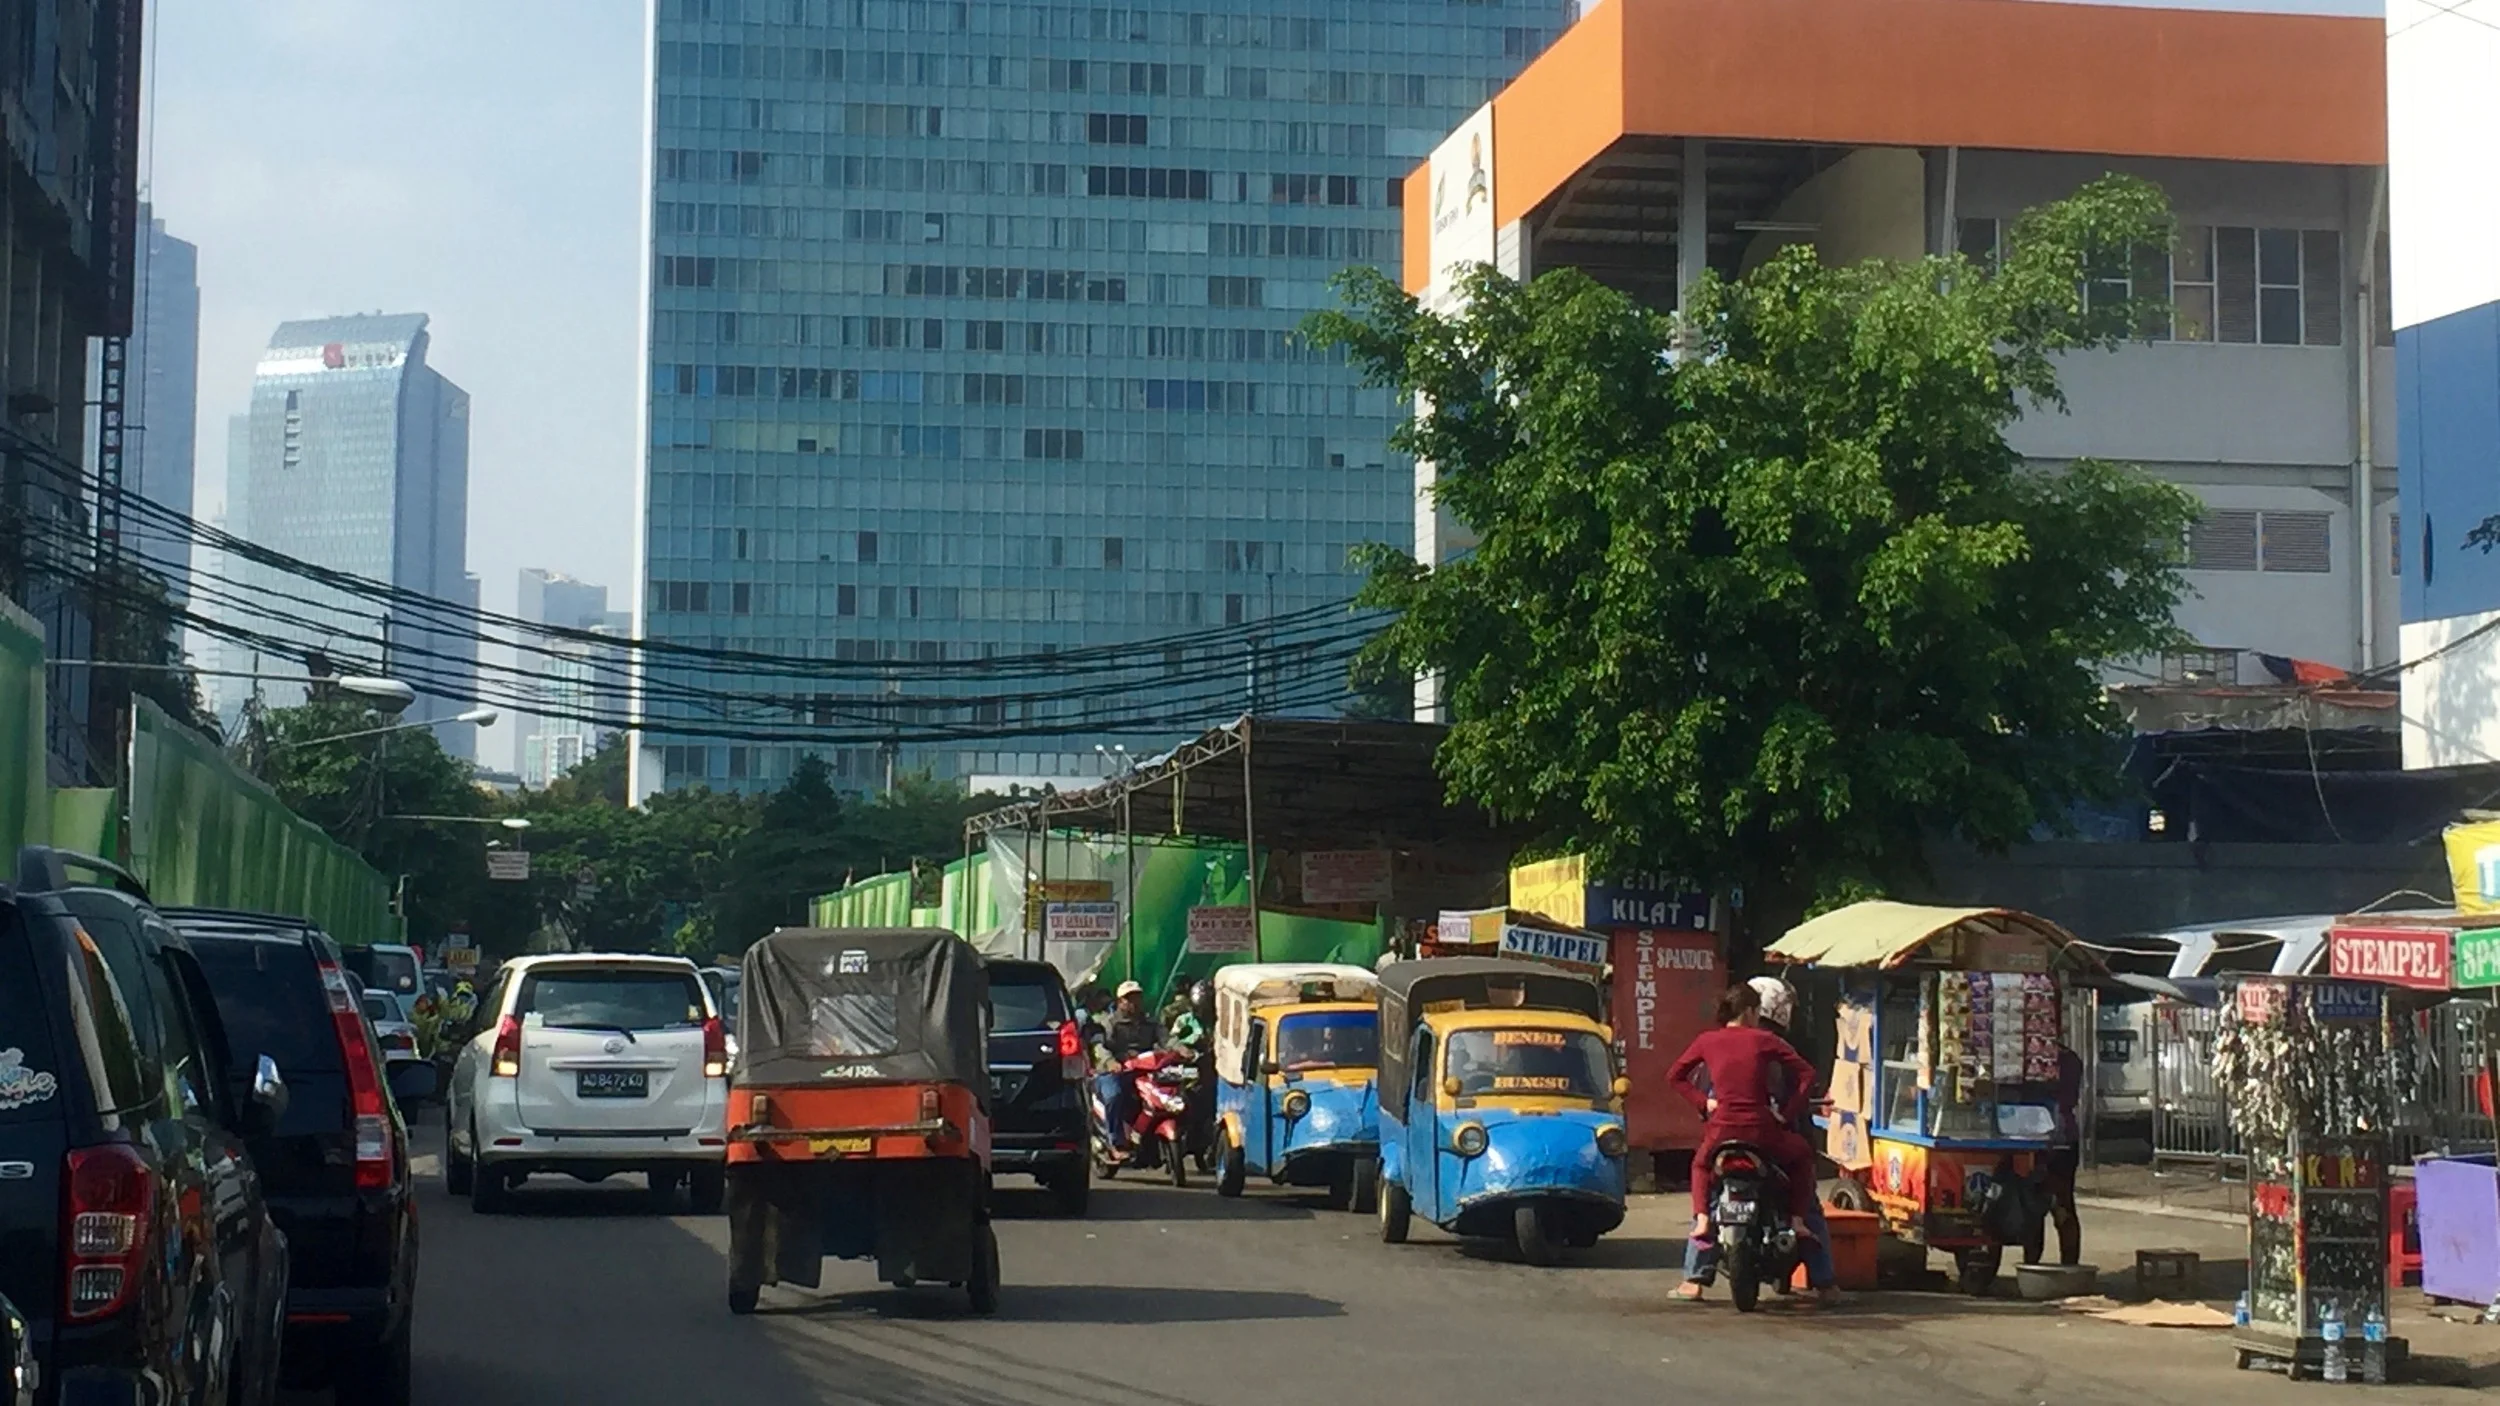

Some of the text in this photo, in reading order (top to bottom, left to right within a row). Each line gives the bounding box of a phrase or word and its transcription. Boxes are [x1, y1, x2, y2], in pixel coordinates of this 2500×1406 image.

[1612, 897, 1682, 925] KILAT
[1506, 928, 1602, 963] STEMPEL
[2335, 937, 2442, 979] STEMPEL
[1635, 930, 1657, 1050] STEMPEL
